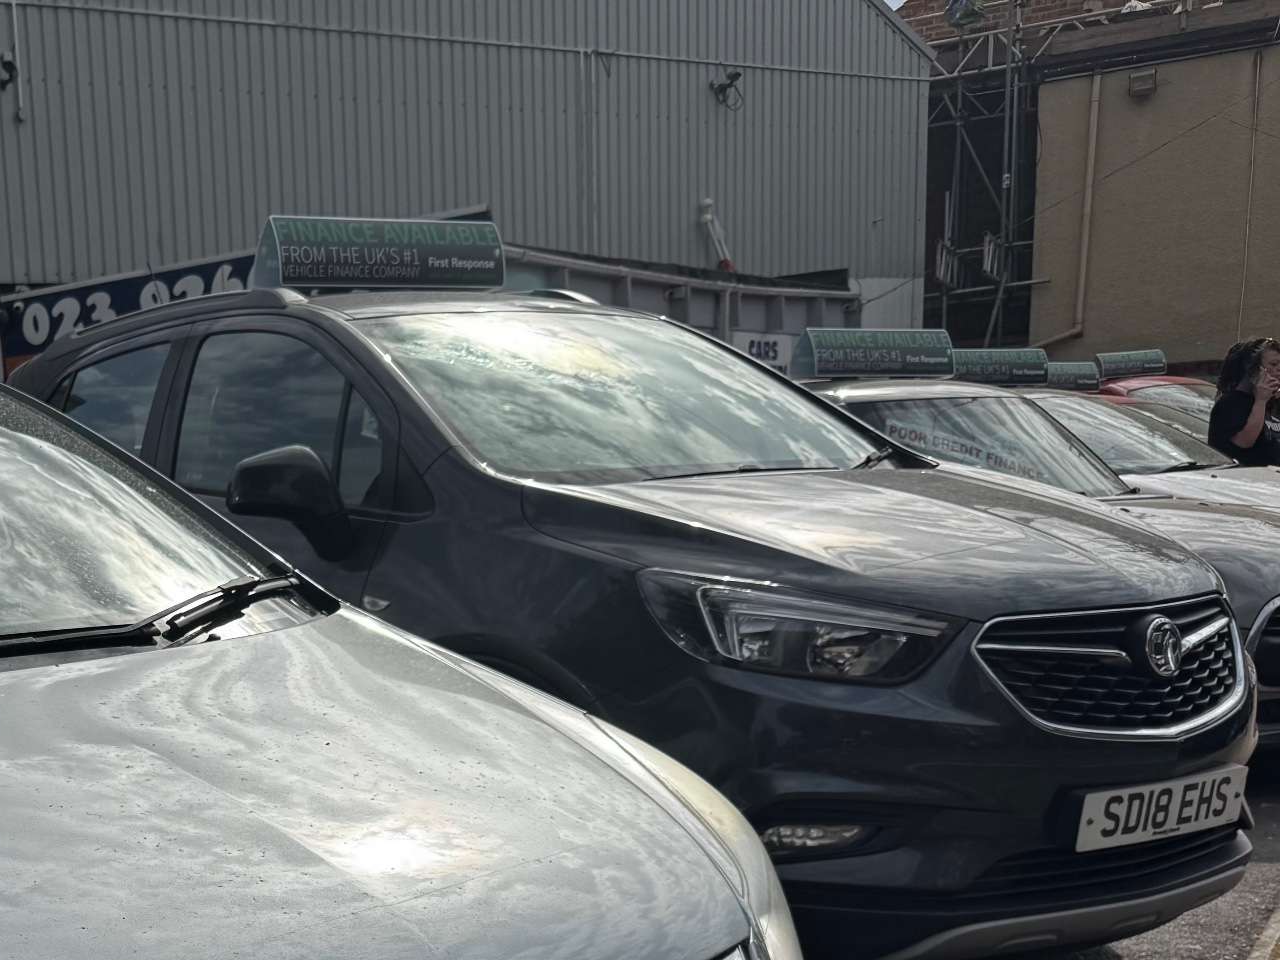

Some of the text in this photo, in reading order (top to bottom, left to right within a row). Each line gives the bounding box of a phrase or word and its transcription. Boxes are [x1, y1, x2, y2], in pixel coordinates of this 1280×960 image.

[276, 220, 498, 246] FINANCE AVAILABLE
[280, 245, 328, 265] FROM
[329, 246, 362, 265] THE
[403, 247, 421, 265] #1
[427, 256, 496, 270] First Response
[283, 264, 327, 279] VEHICLE
[328, 264, 371, 279] FINANCE
[372, 264, 421, 280] COMPANY
[22, 292, 118, 346] 023
[748, 339, 779, 362] CARS
[888, 424, 928, 444] POOR
[931, 437, 983, 459] CREDIT
[985, 452, 1043, 479] FINANCE
[1100, 775, 1232, 838] SD18 EHS
